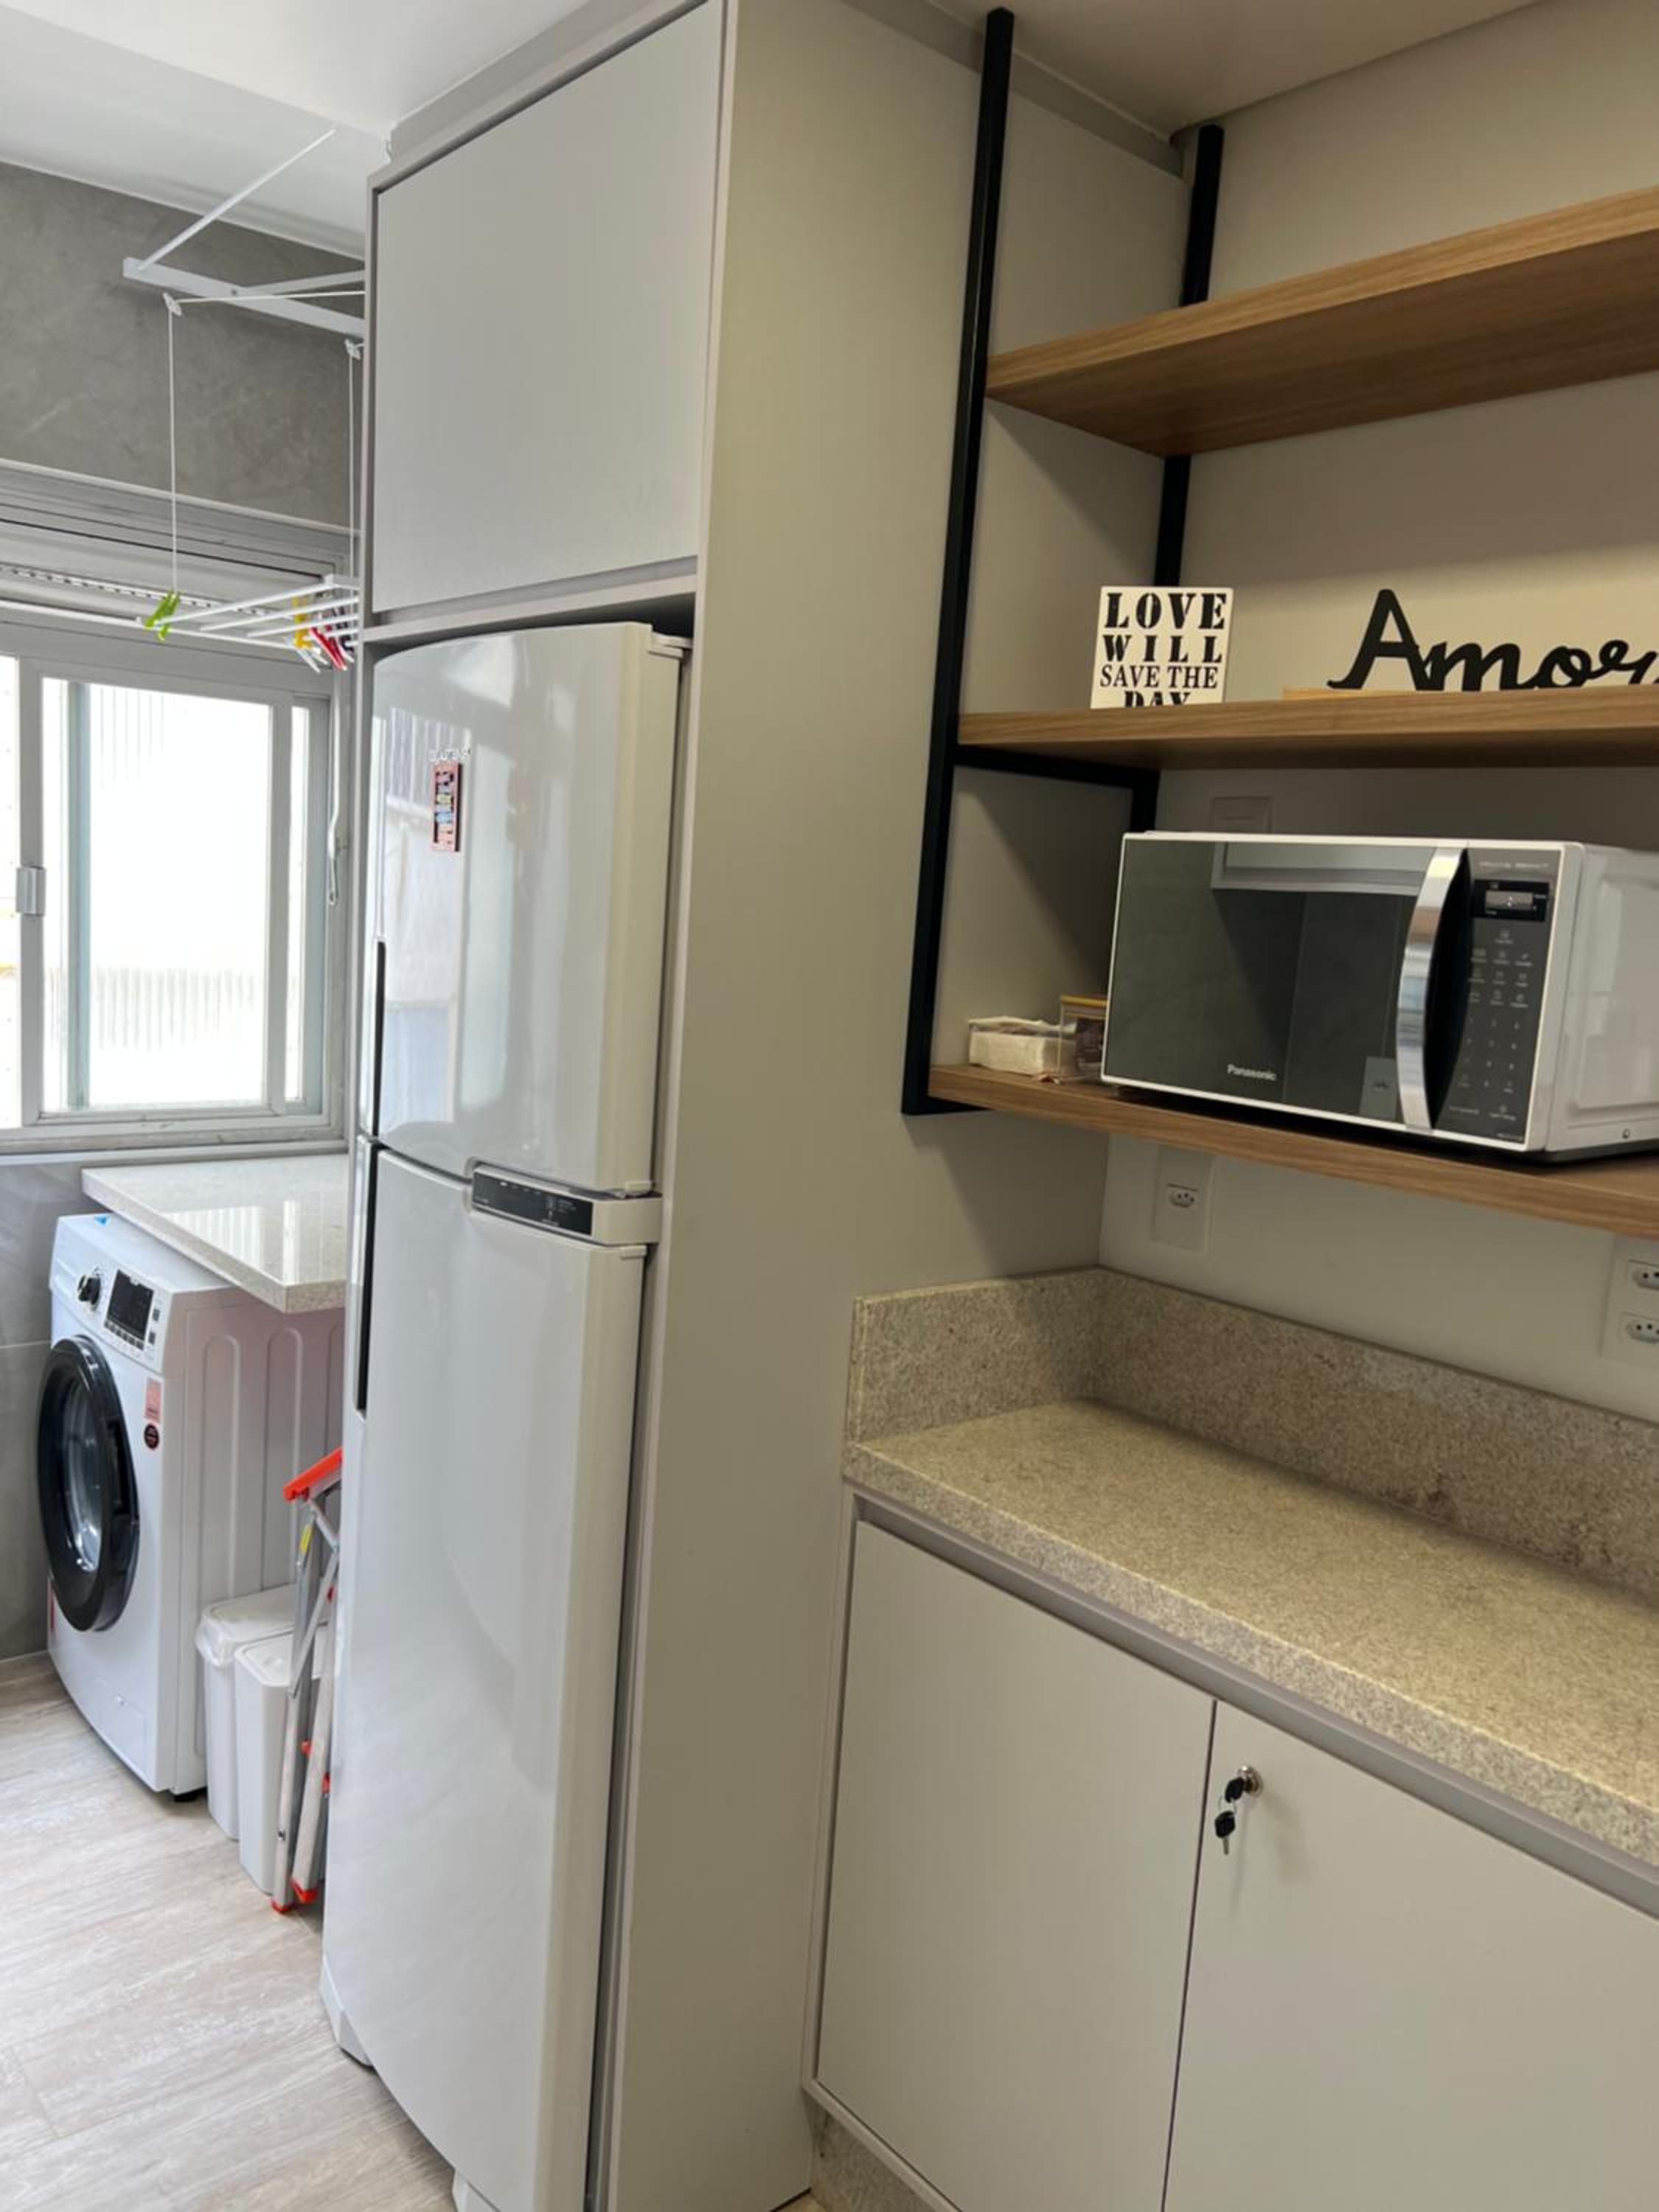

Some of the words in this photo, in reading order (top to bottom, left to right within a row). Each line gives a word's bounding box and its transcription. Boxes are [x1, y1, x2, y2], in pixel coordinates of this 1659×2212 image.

[1105, 593, 1226, 629] LOVE
[1103, 635, 1222, 663] WILL
[1100, 664, 1161, 687] SAVE
[1167, 666, 1218, 688] THE
[1226, 1064, 1276, 1081] Panasonic
